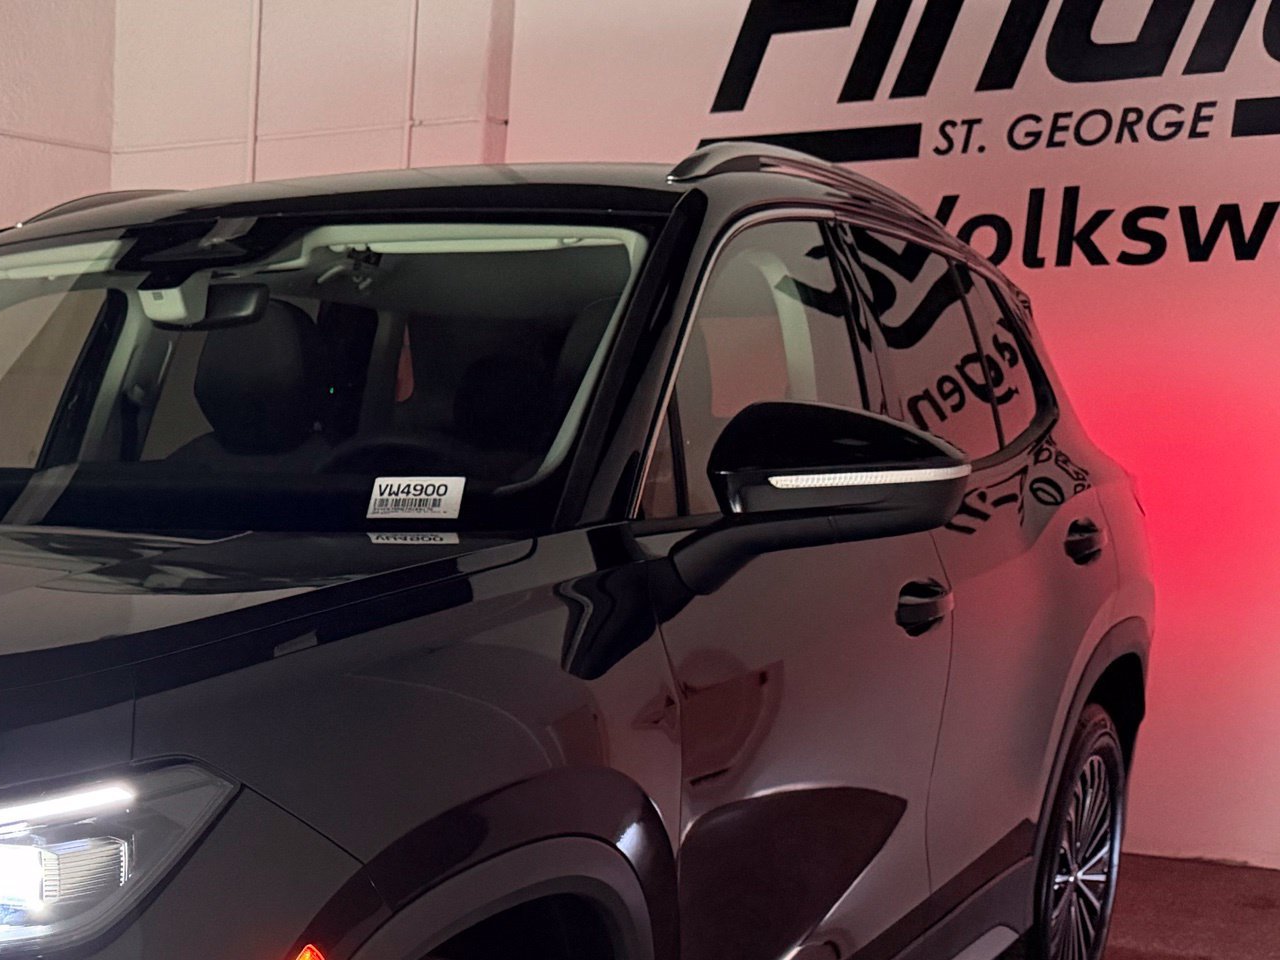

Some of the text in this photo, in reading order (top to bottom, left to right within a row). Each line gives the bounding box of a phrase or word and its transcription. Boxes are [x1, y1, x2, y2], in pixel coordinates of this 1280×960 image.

[933, 101, 1218, 155] ST. GEORGE
[378, 483, 449, 497] VW4900
